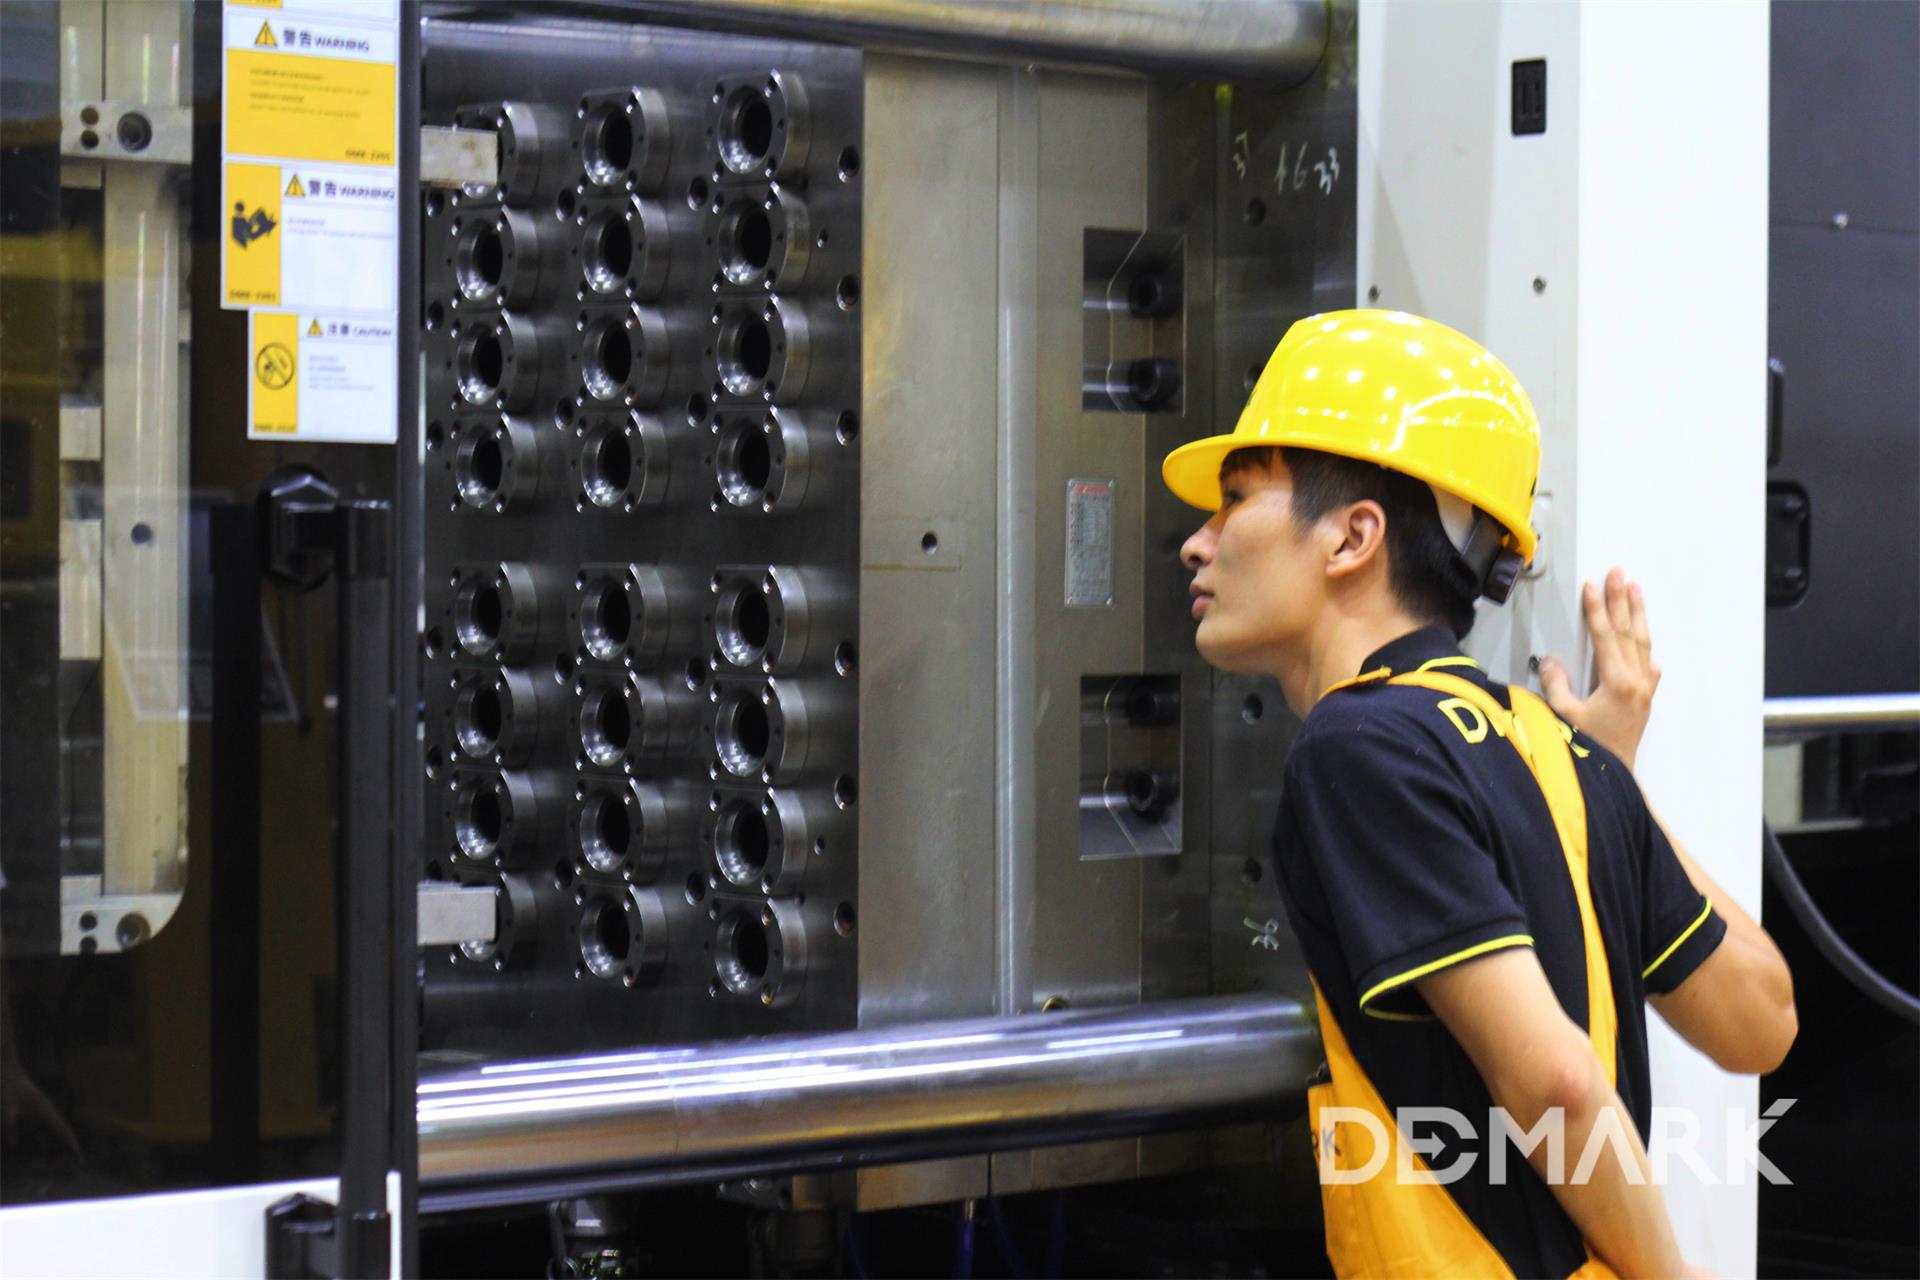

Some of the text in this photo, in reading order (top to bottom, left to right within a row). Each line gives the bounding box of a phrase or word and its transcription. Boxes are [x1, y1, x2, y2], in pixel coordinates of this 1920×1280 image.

[283, 29, 370, 52] 警告 WARNING
[308, 179, 395, 200] 警告 WARNING
